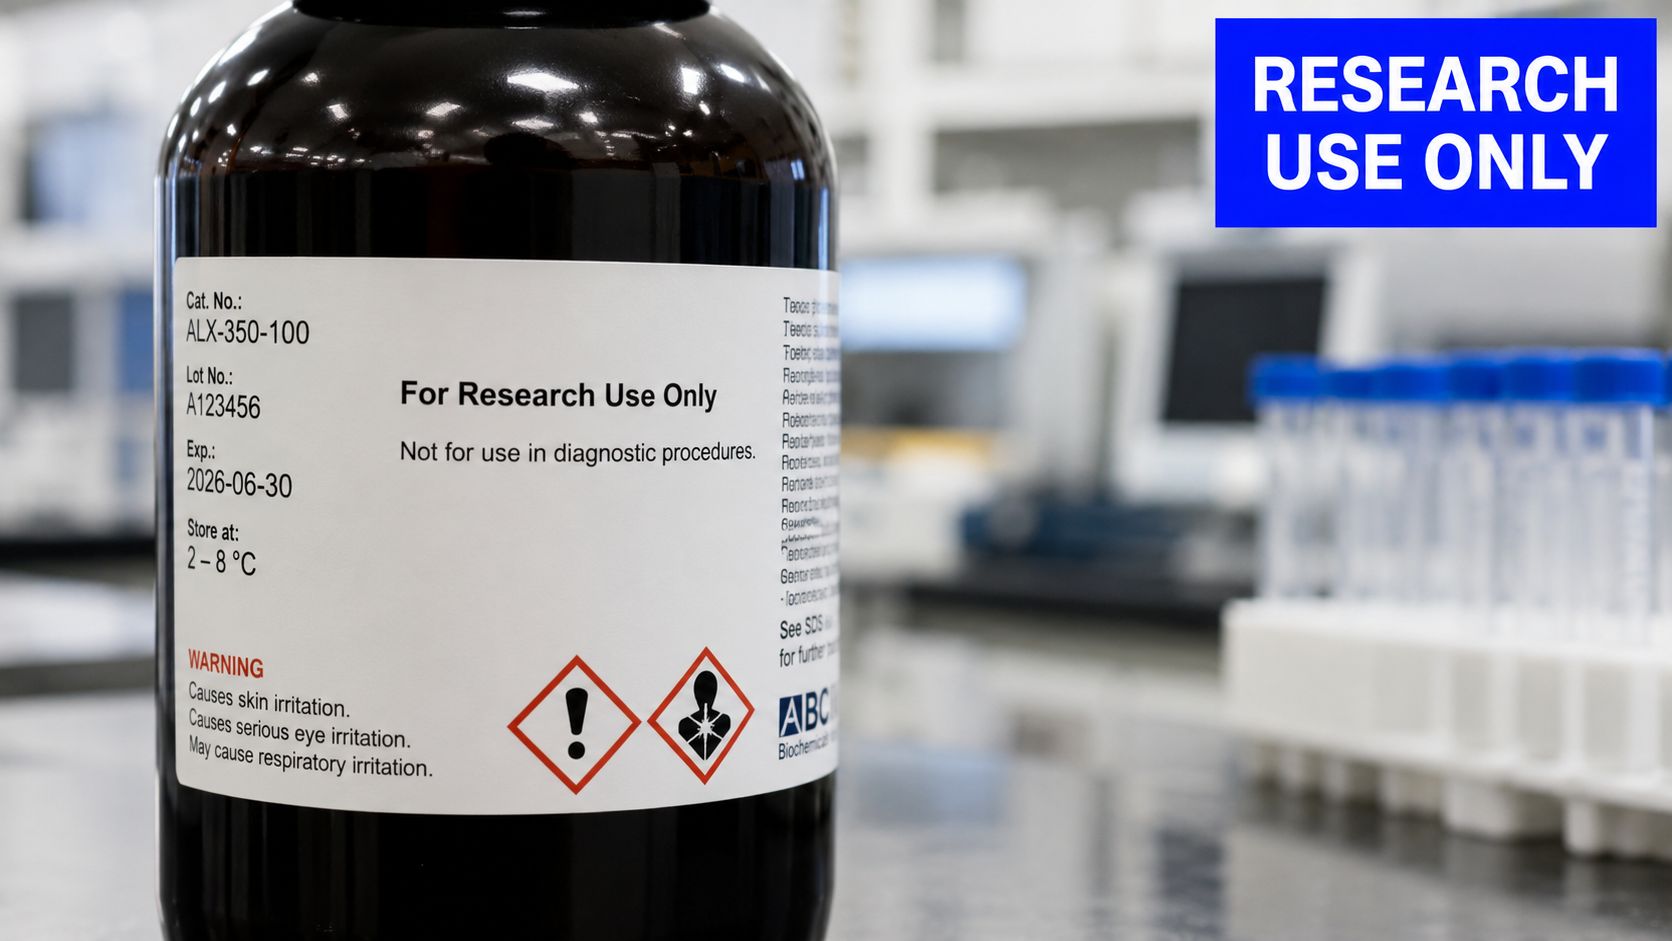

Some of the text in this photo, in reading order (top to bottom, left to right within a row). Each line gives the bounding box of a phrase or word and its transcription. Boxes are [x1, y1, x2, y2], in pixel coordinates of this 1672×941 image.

[186, 290, 242, 310] Cat. No.:
[186, 318, 310, 345] ALX-350-100
[186, 365, 233, 386] Lot No.:
[186, 391, 261, 419] A123456
[400, 380, 718, 413] For Research Use Only
[186, 438, 216, 463] Exp.:
[400, 440, 438, 461] Not
[444, 441, 474, 462] for
[481, 446, 521, 463] use
[528, 442, 547, 463] in
[553, 442, 657, 468] diagnostic
[662, 441, 756, 467] procedures.
[186, 466, 293, 499] 2026-06-30
[187, 517, 240, 542] Store at:
[187, 545, 196, 570] 2
[215, 548, 227, 574] 8
[232, 549, 257, 577] °C
[780, 620, 802, 640] See
[804, 614, 824, 636] SDS
[188, 648, 264, 679] WARNING
[779, 648, 796, 668] for
[188, 681, 351, 718] Causes skin irritation.
[779, 687, 829, 738] ABC
[189, 708, 411, 748] Causes serious eye irritation.
[189, 734, 433, 778] May cause respiratory irritation.
